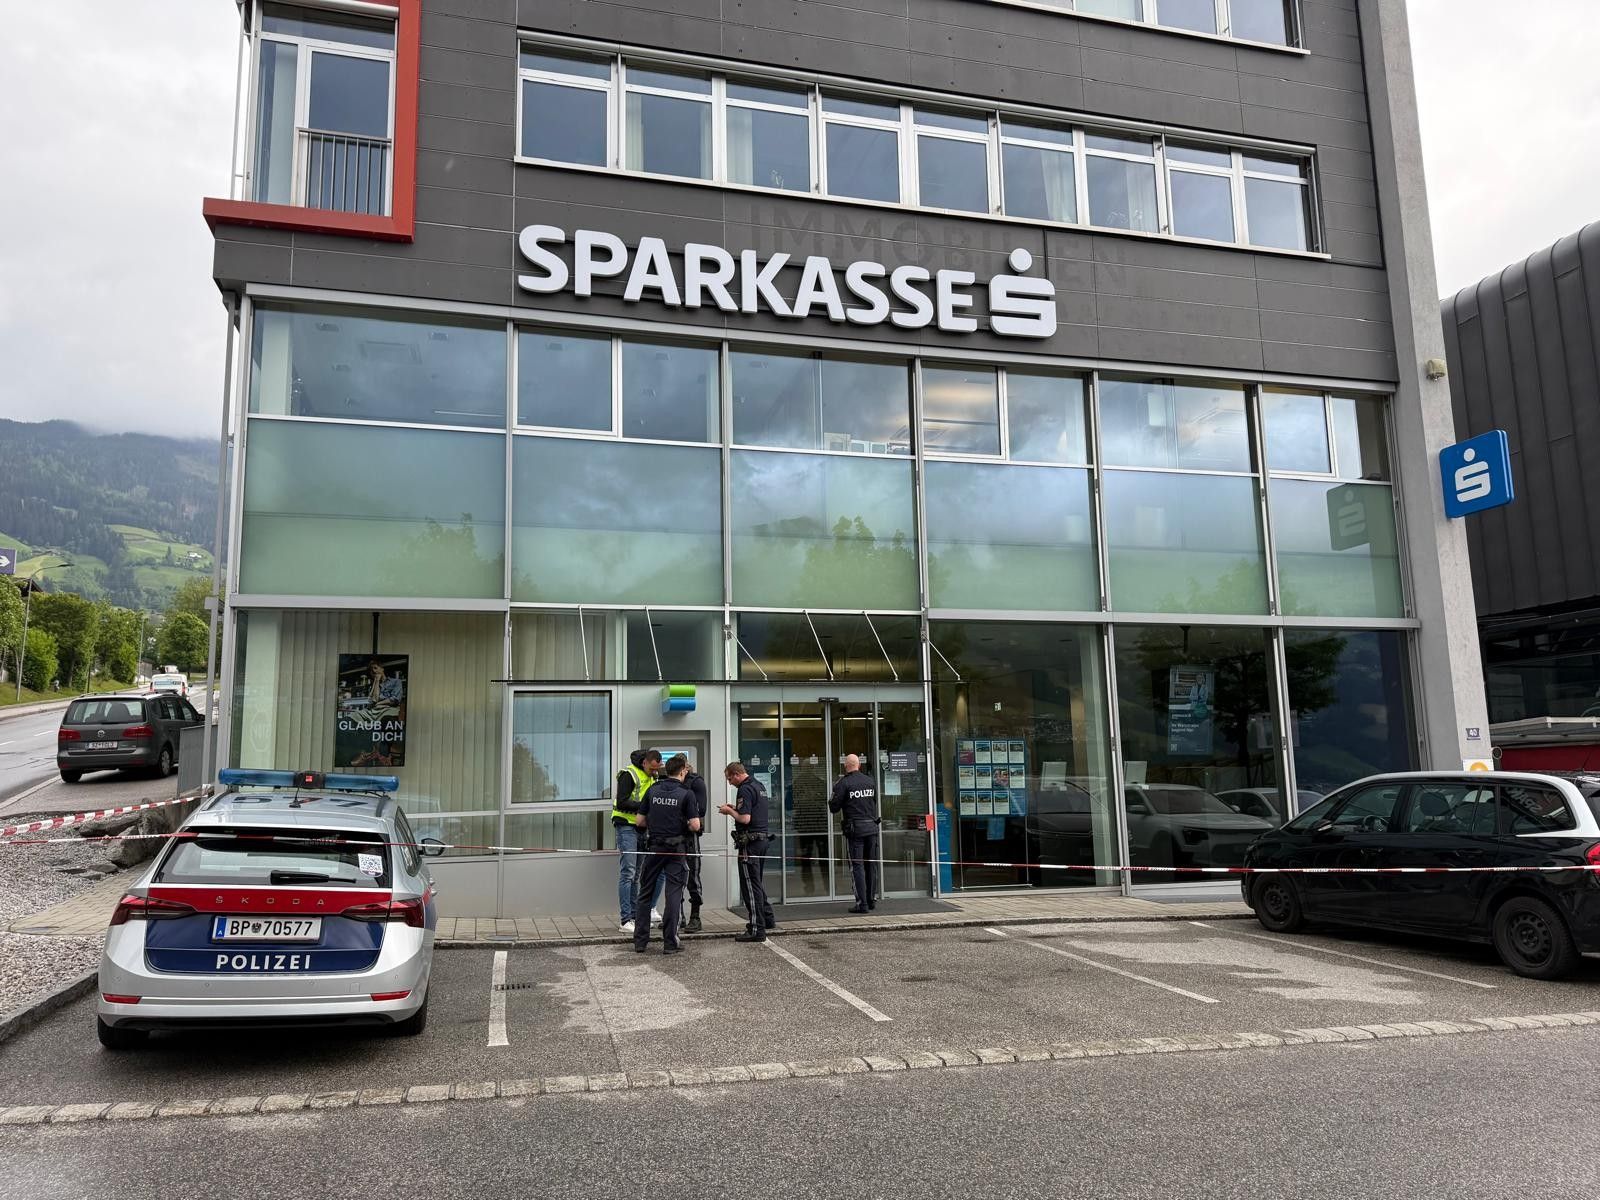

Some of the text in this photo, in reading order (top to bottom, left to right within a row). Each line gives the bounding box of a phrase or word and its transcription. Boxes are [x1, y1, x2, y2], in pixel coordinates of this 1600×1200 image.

[517, 224, 978, 334] SPARKASSE
[339, 721, 403, 730] GLAUB AN
[372, 732, 403, 741] DICH
[652, 796, 678, 806] POLIZEI
[230, 921, 250, 936] BP
[263, 921, 313, 936] 70577
[216, 954, 311, 970] POLIZEI
